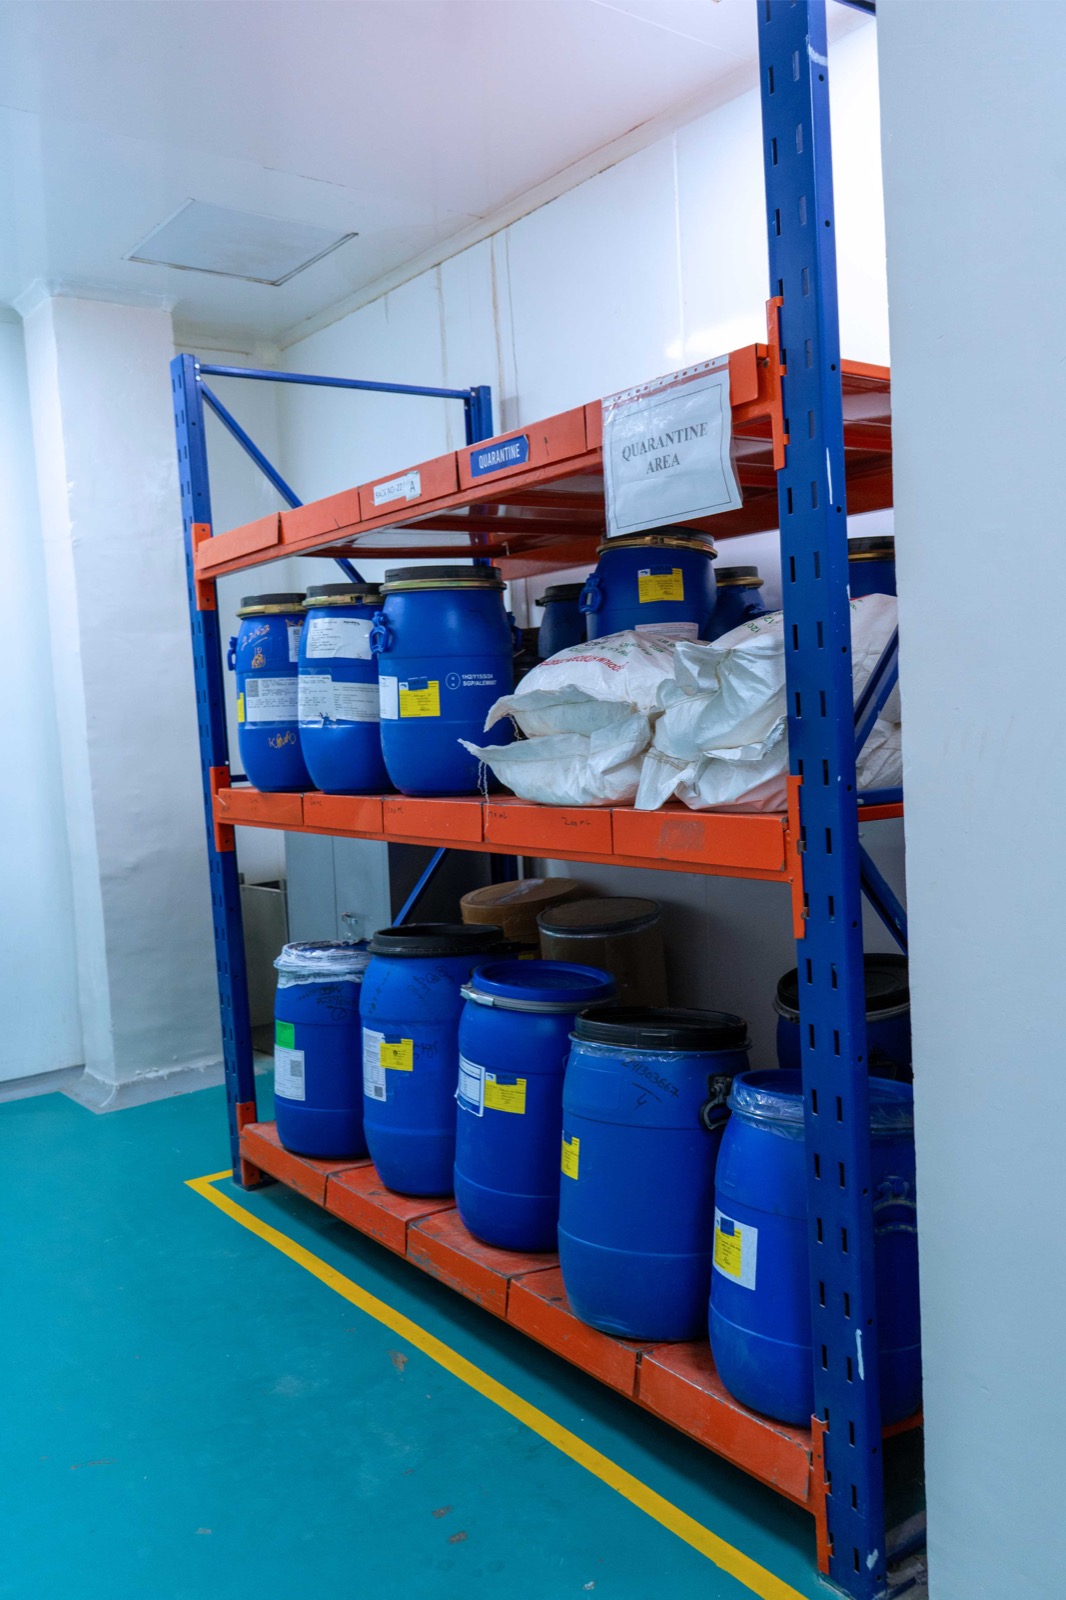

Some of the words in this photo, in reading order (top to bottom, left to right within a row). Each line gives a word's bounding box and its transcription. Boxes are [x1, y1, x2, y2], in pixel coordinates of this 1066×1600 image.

[622, 422, 708, 461] QUARANTINE
[478, 443, 520, 469] QUARANTINE
[645, 453, 680, 475] AREA
[409, 480, 416, 492] A
